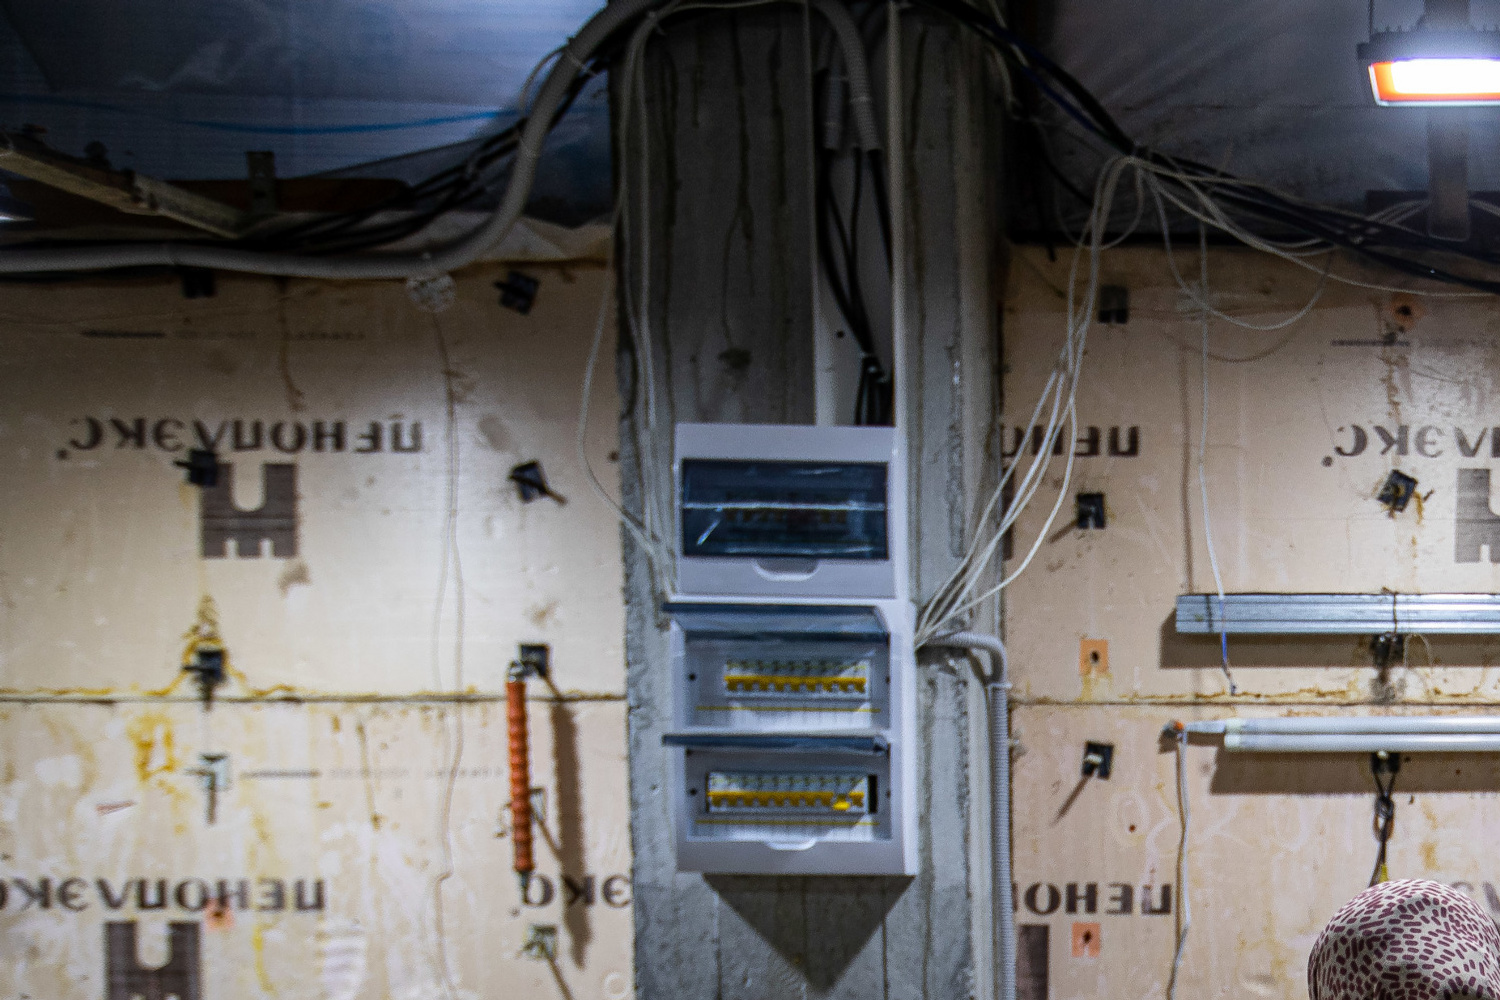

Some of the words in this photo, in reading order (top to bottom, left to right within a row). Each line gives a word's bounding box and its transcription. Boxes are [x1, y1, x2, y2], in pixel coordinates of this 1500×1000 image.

[66, 415, 425, 455] ПЕНОПЛЭКС
[0, 877, 327, 911] ПЕНОПЛЭК
[1011, 880, 1173, 916] ПЕНО
